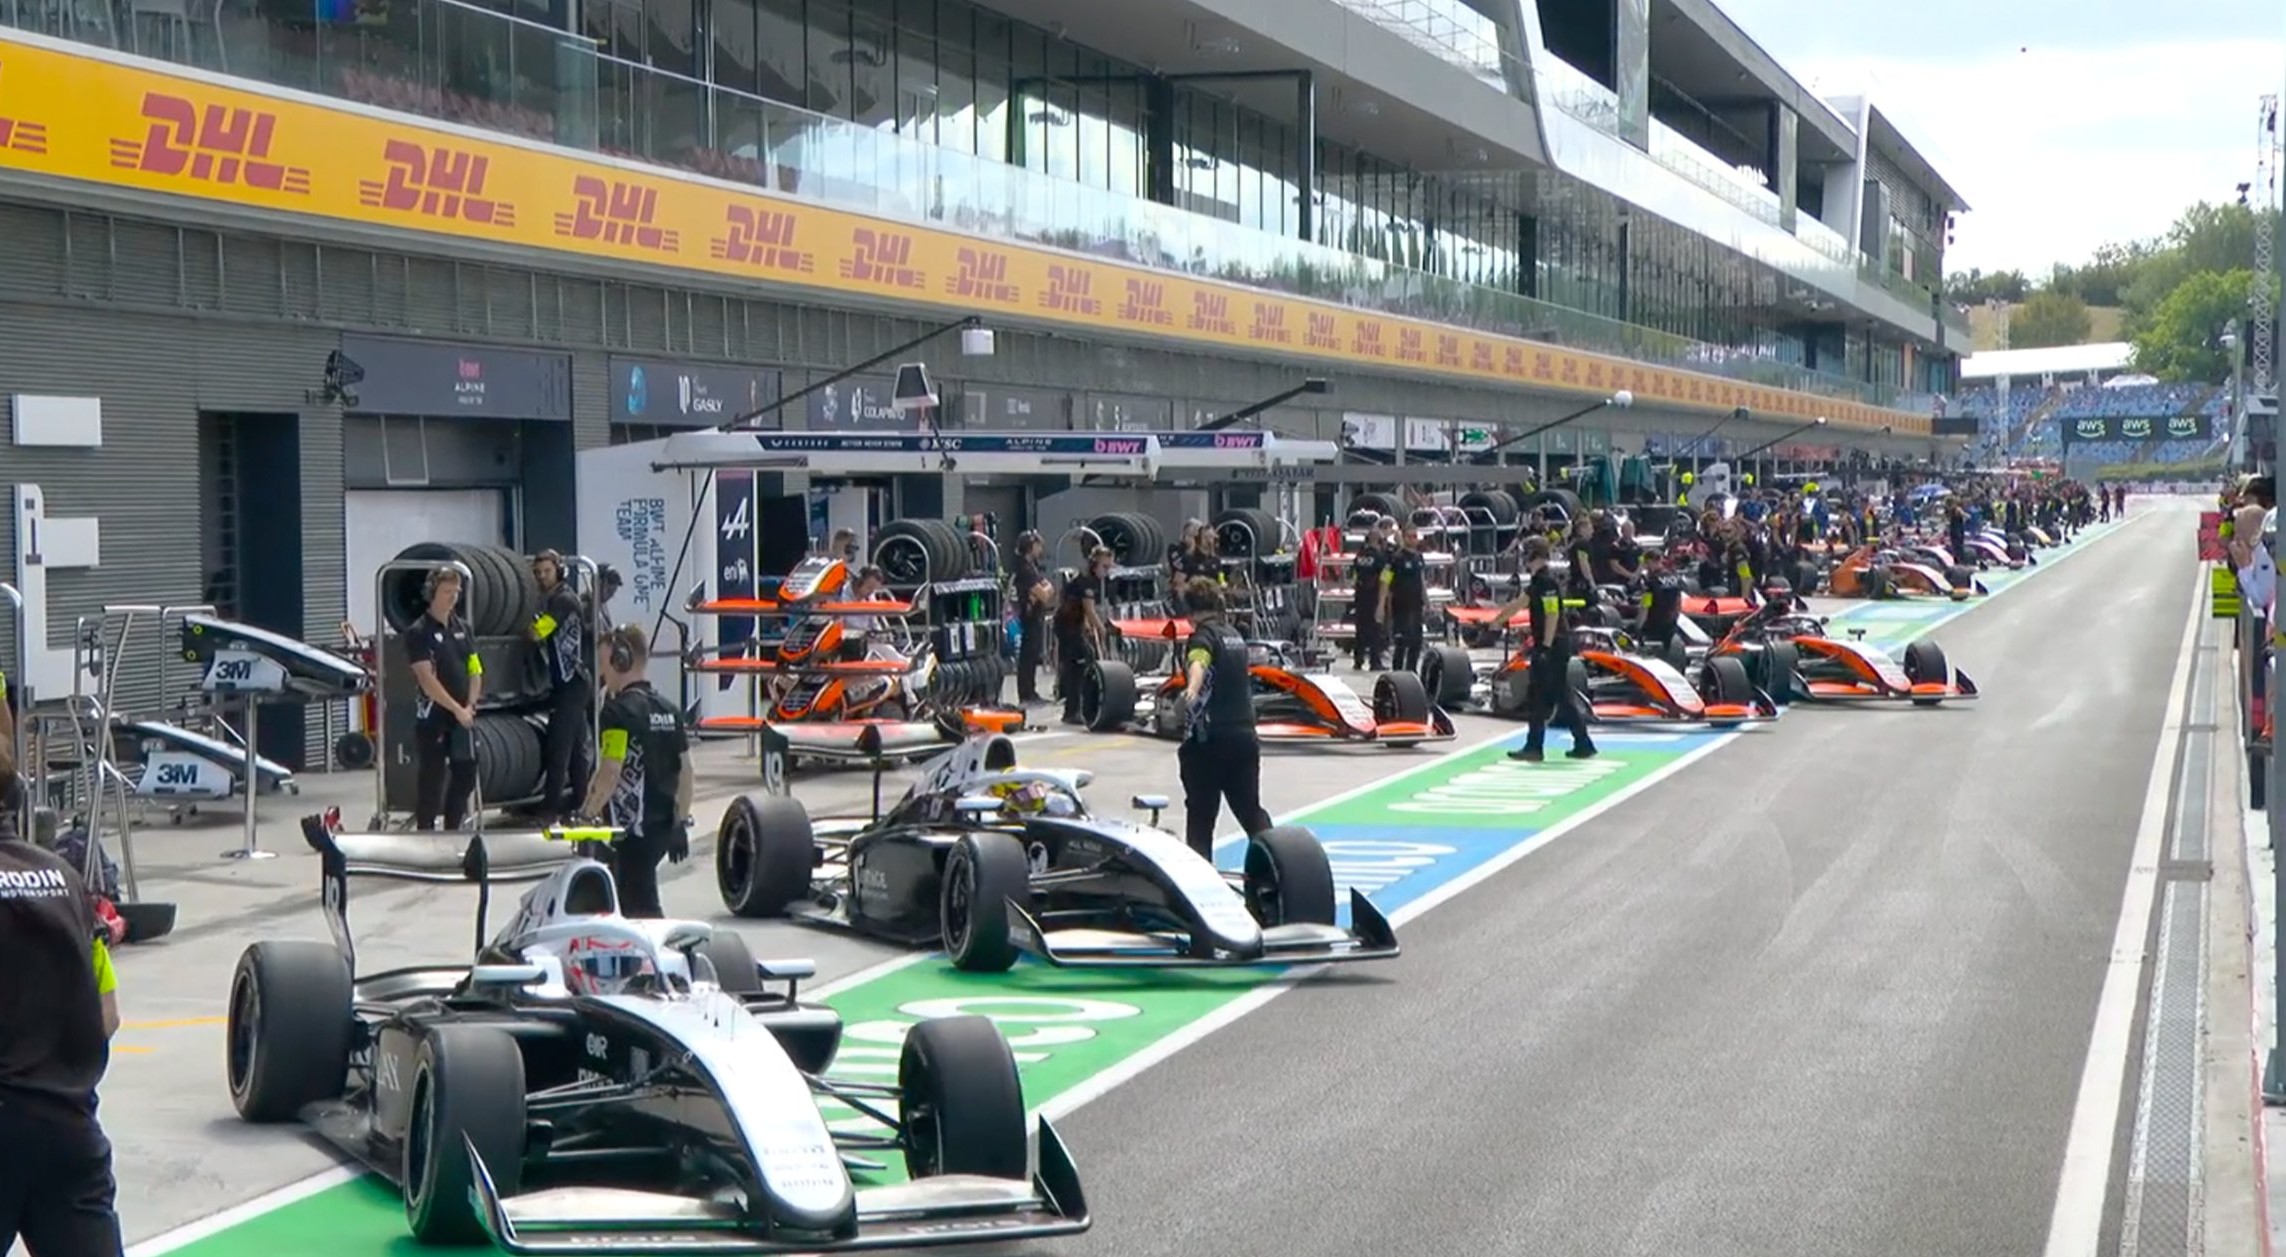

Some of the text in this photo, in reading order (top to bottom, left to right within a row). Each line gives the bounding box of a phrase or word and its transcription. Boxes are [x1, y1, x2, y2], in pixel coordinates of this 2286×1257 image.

[141, 92, 285, 191] DHL
[383, 139, 497, 223] DHL
[572, 175, 662, 249] DHL
[726, 204, 800, 270] DHL
[852, 227, 914, 287] DHL
[957, 247, 1009, 301] DHL
[1048, 265, 1093, 314] DHL
[1126, 279, 1166, 325] DHL
[1194, 291, 1231, 334] DHL
[1255, 303, 1286, 342] DHL
[455, 383, 485, 394] ALPINE
[693, 399, 723, 414] GASLY
[2077, 420, 2105, 433] aws
[2122, 419, 2150, 433] aws
[2168, 417, 2196, 431] aws
[616, 501, 632, 541] TEAM
[633, 498, 650, 569] FORMULA
[650, 498, 665, 533] BWT
[215, 660, 250, 680] 3M
[157, 764, 197, 784] 3M
[0, 868, 66, 888] RODIN
[0, 888, 70, 898] MOTORSPORT
